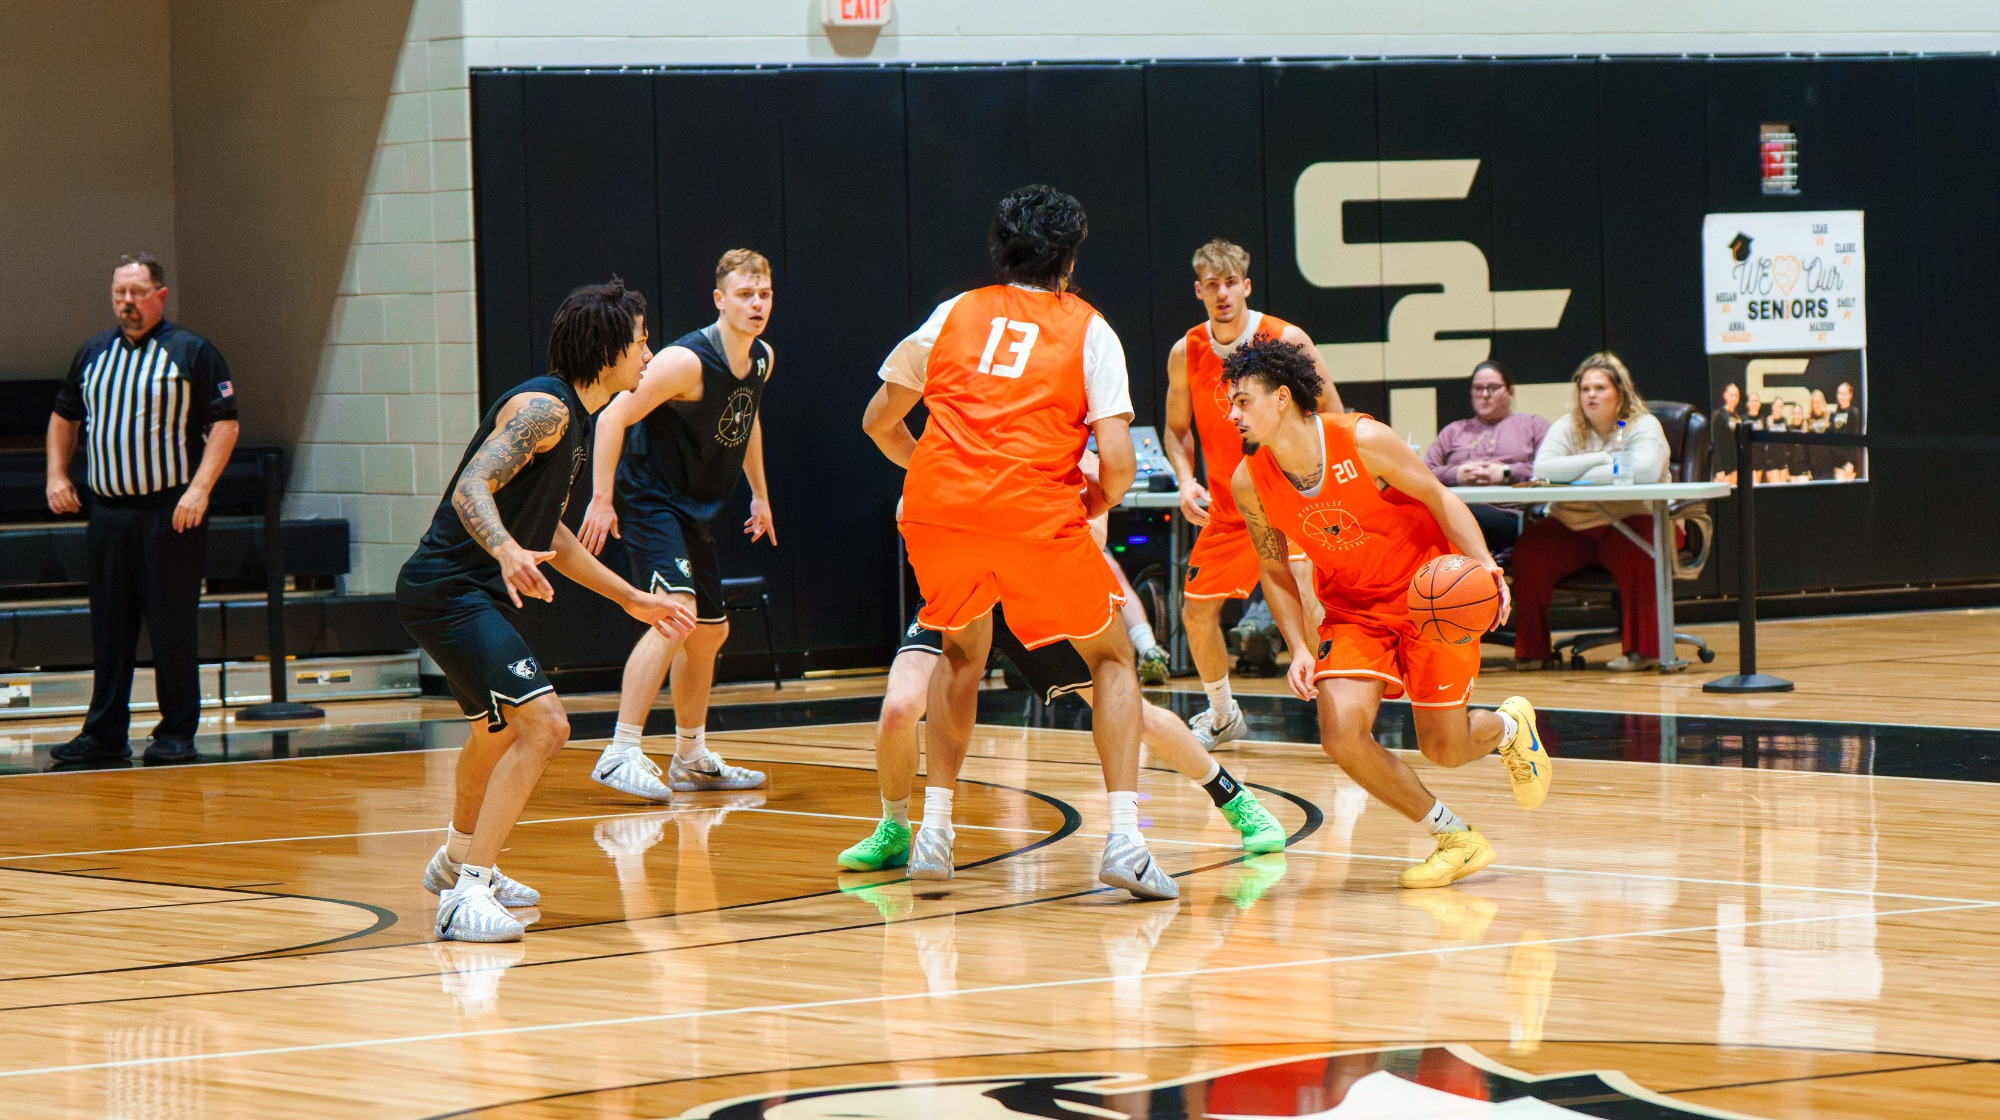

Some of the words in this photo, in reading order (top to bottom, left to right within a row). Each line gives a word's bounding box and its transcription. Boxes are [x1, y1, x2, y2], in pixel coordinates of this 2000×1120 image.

[1802, 256, 1844, 293] Our
[977, 316, 1040, 379] 13
[1331, 459, 1359, 484] 20
